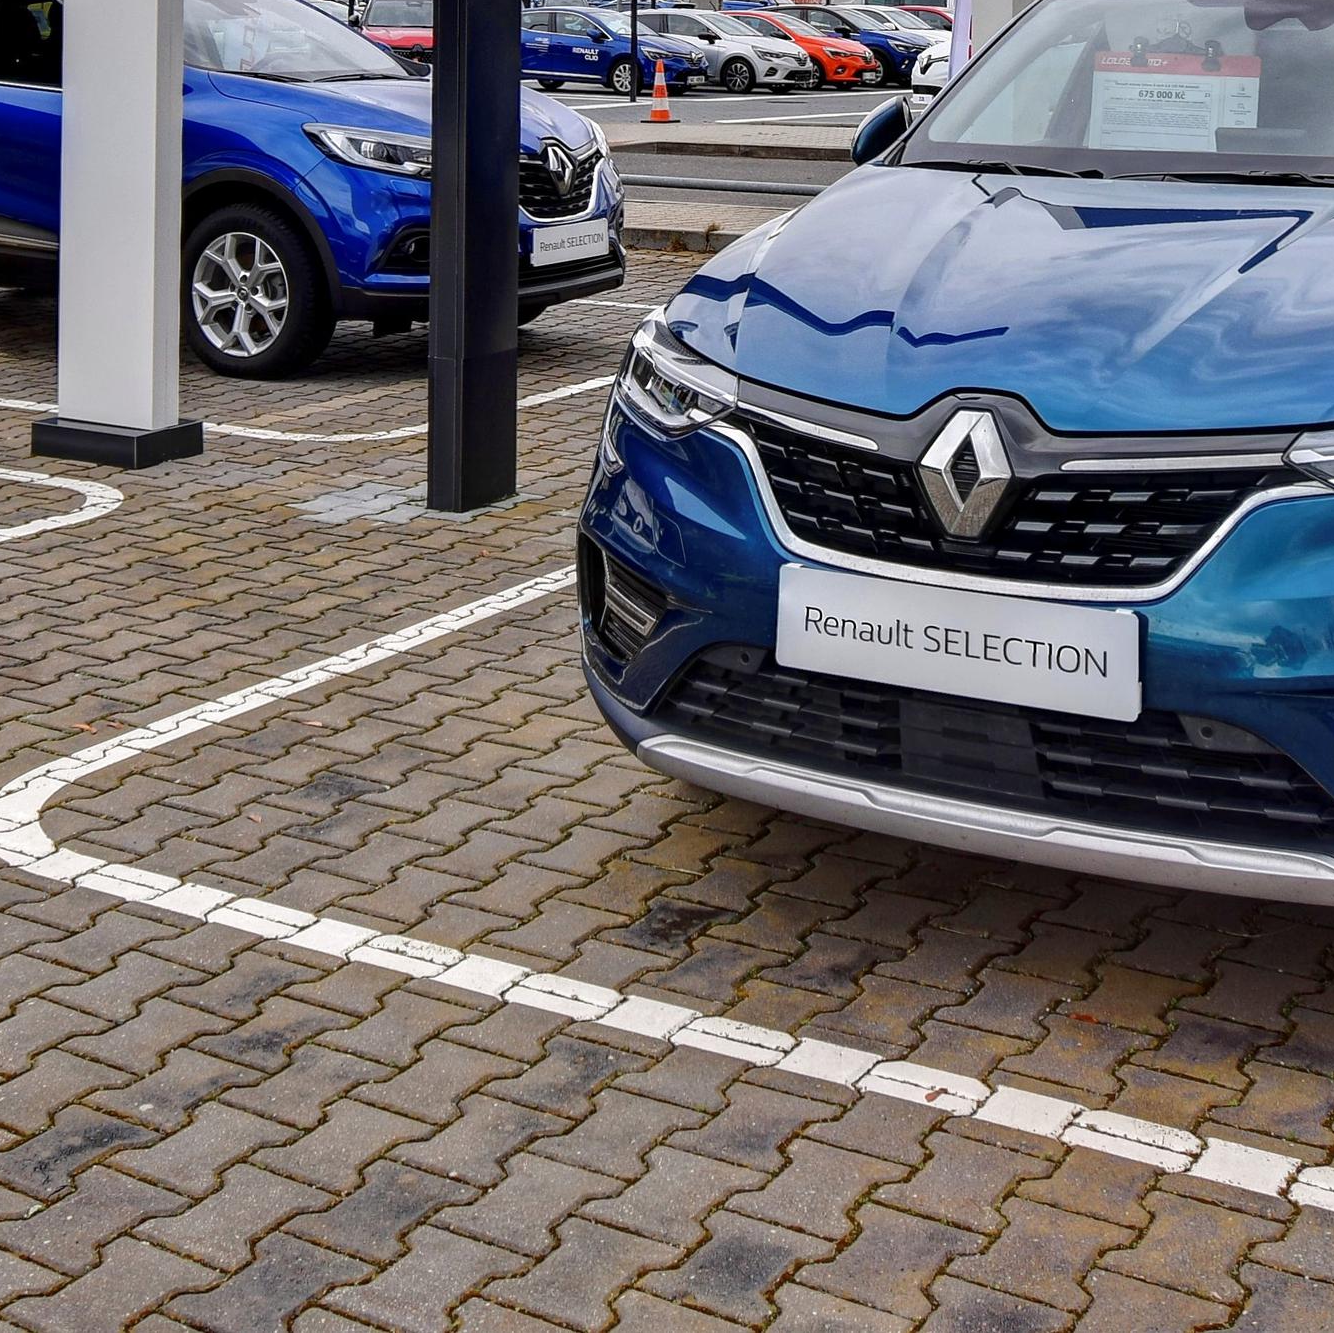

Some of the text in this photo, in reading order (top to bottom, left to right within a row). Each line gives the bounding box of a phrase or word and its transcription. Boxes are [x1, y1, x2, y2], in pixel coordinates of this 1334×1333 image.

[571, 46, 599, 55] RENAULT
[1138, 89, 1186, 100] 675 000 Kč
[539, 231, 604, 253] Renault SELECTION
[803, 605, 1109, 679] Renault SELECTION
